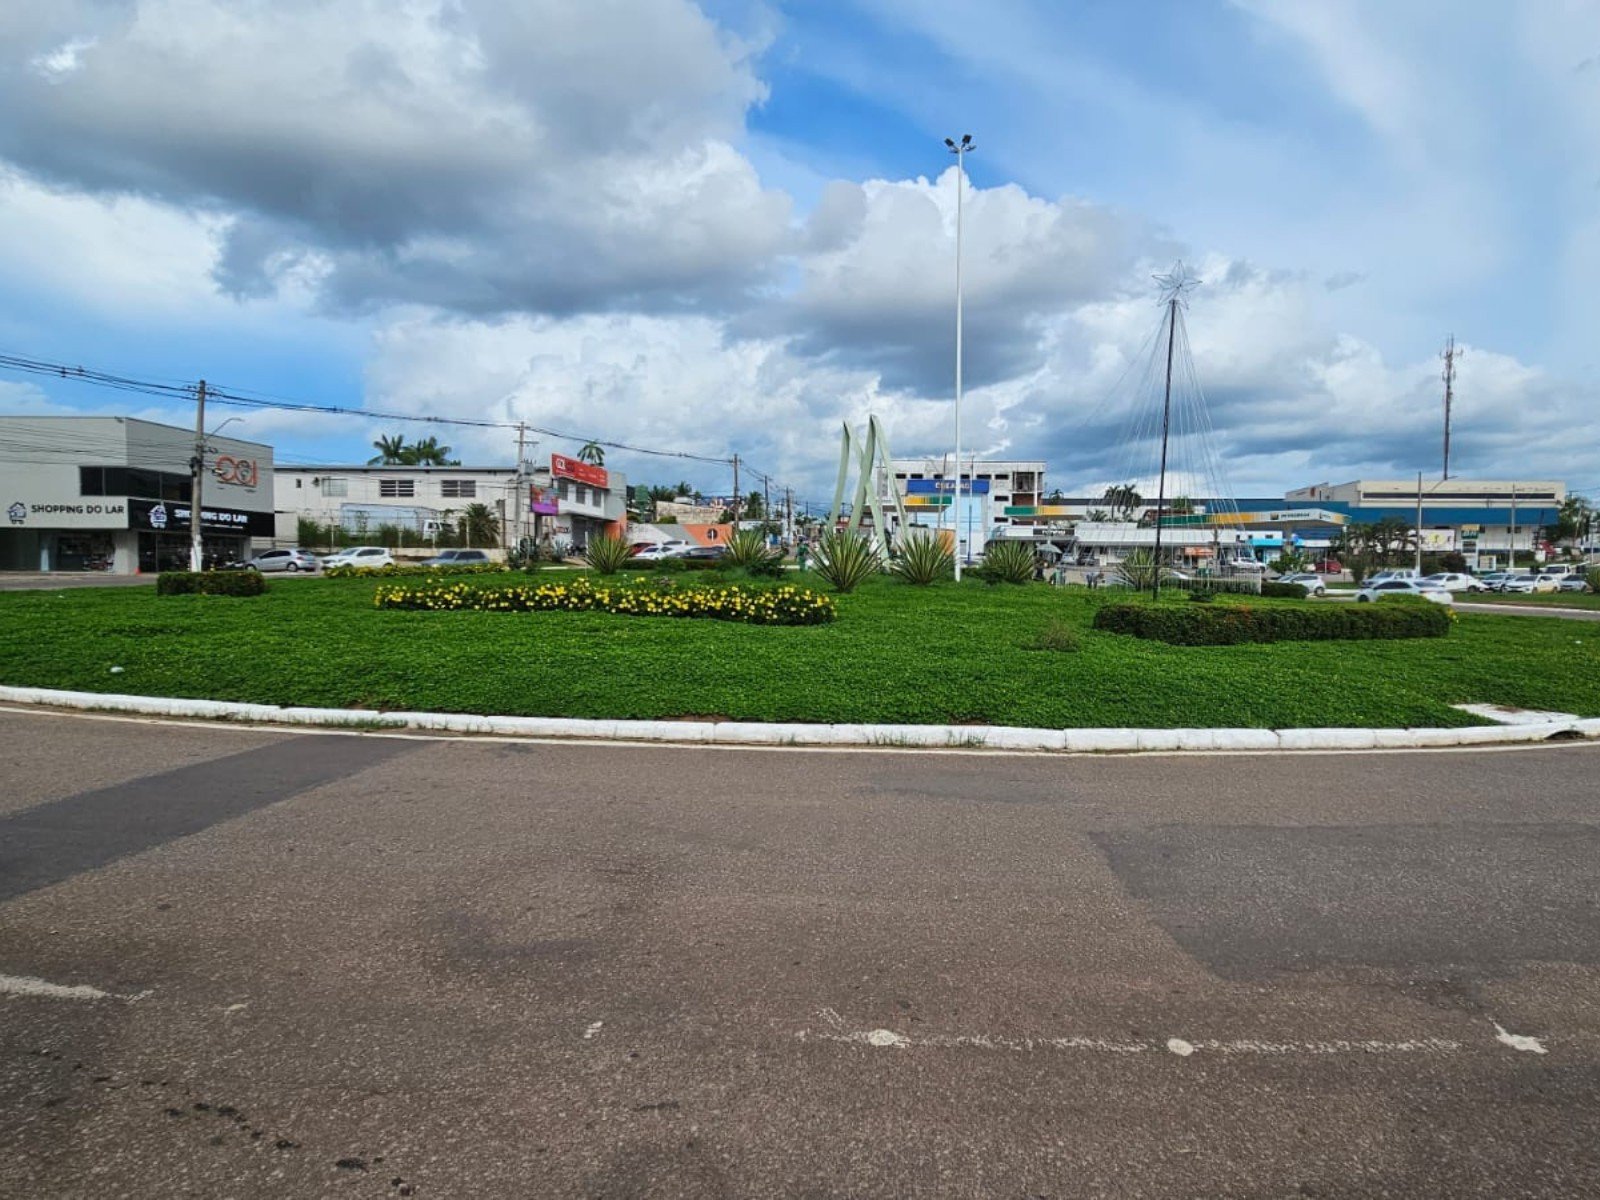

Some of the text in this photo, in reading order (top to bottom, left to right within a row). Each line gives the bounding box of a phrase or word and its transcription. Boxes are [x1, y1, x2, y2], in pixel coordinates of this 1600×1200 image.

[31, 504, 124, 514] SHOPPING DO LAR
[174, 509, 217, 520] SHOING
[218, 512, 232, 522] DO
